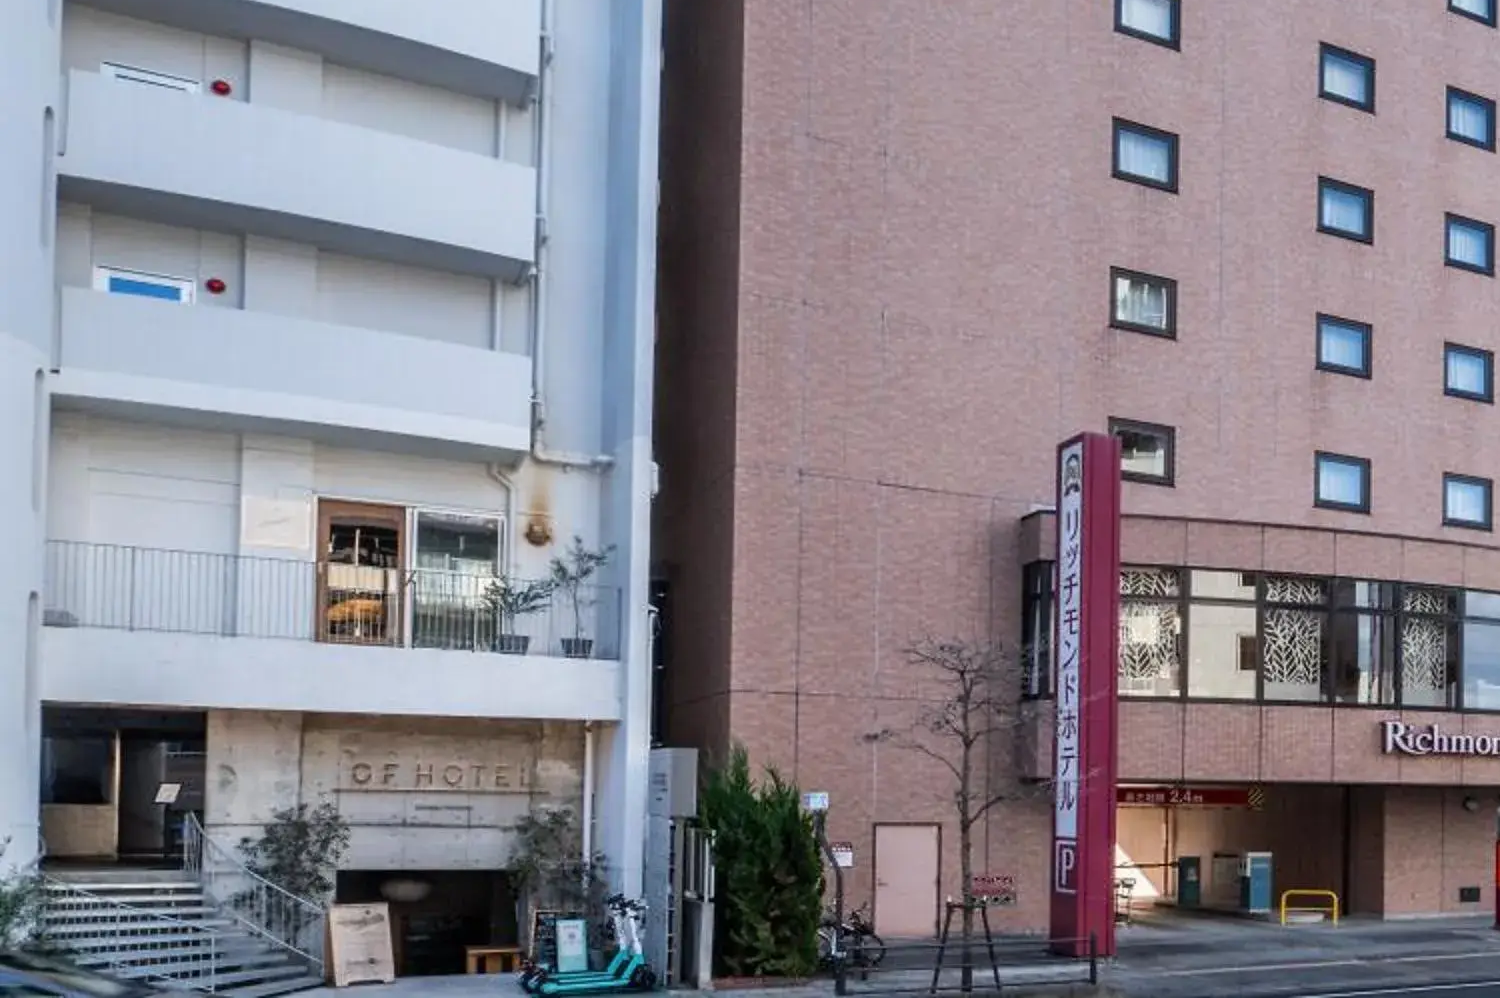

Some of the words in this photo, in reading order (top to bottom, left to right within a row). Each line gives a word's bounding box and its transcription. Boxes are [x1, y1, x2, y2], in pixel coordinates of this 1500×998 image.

[1060, 509, 1079, 811] リッチモンドホテル
[351, 762, 400, 785] OF
[413, 763, 536, 788] HOTEL
[1060, 848, 1075, 886] P
